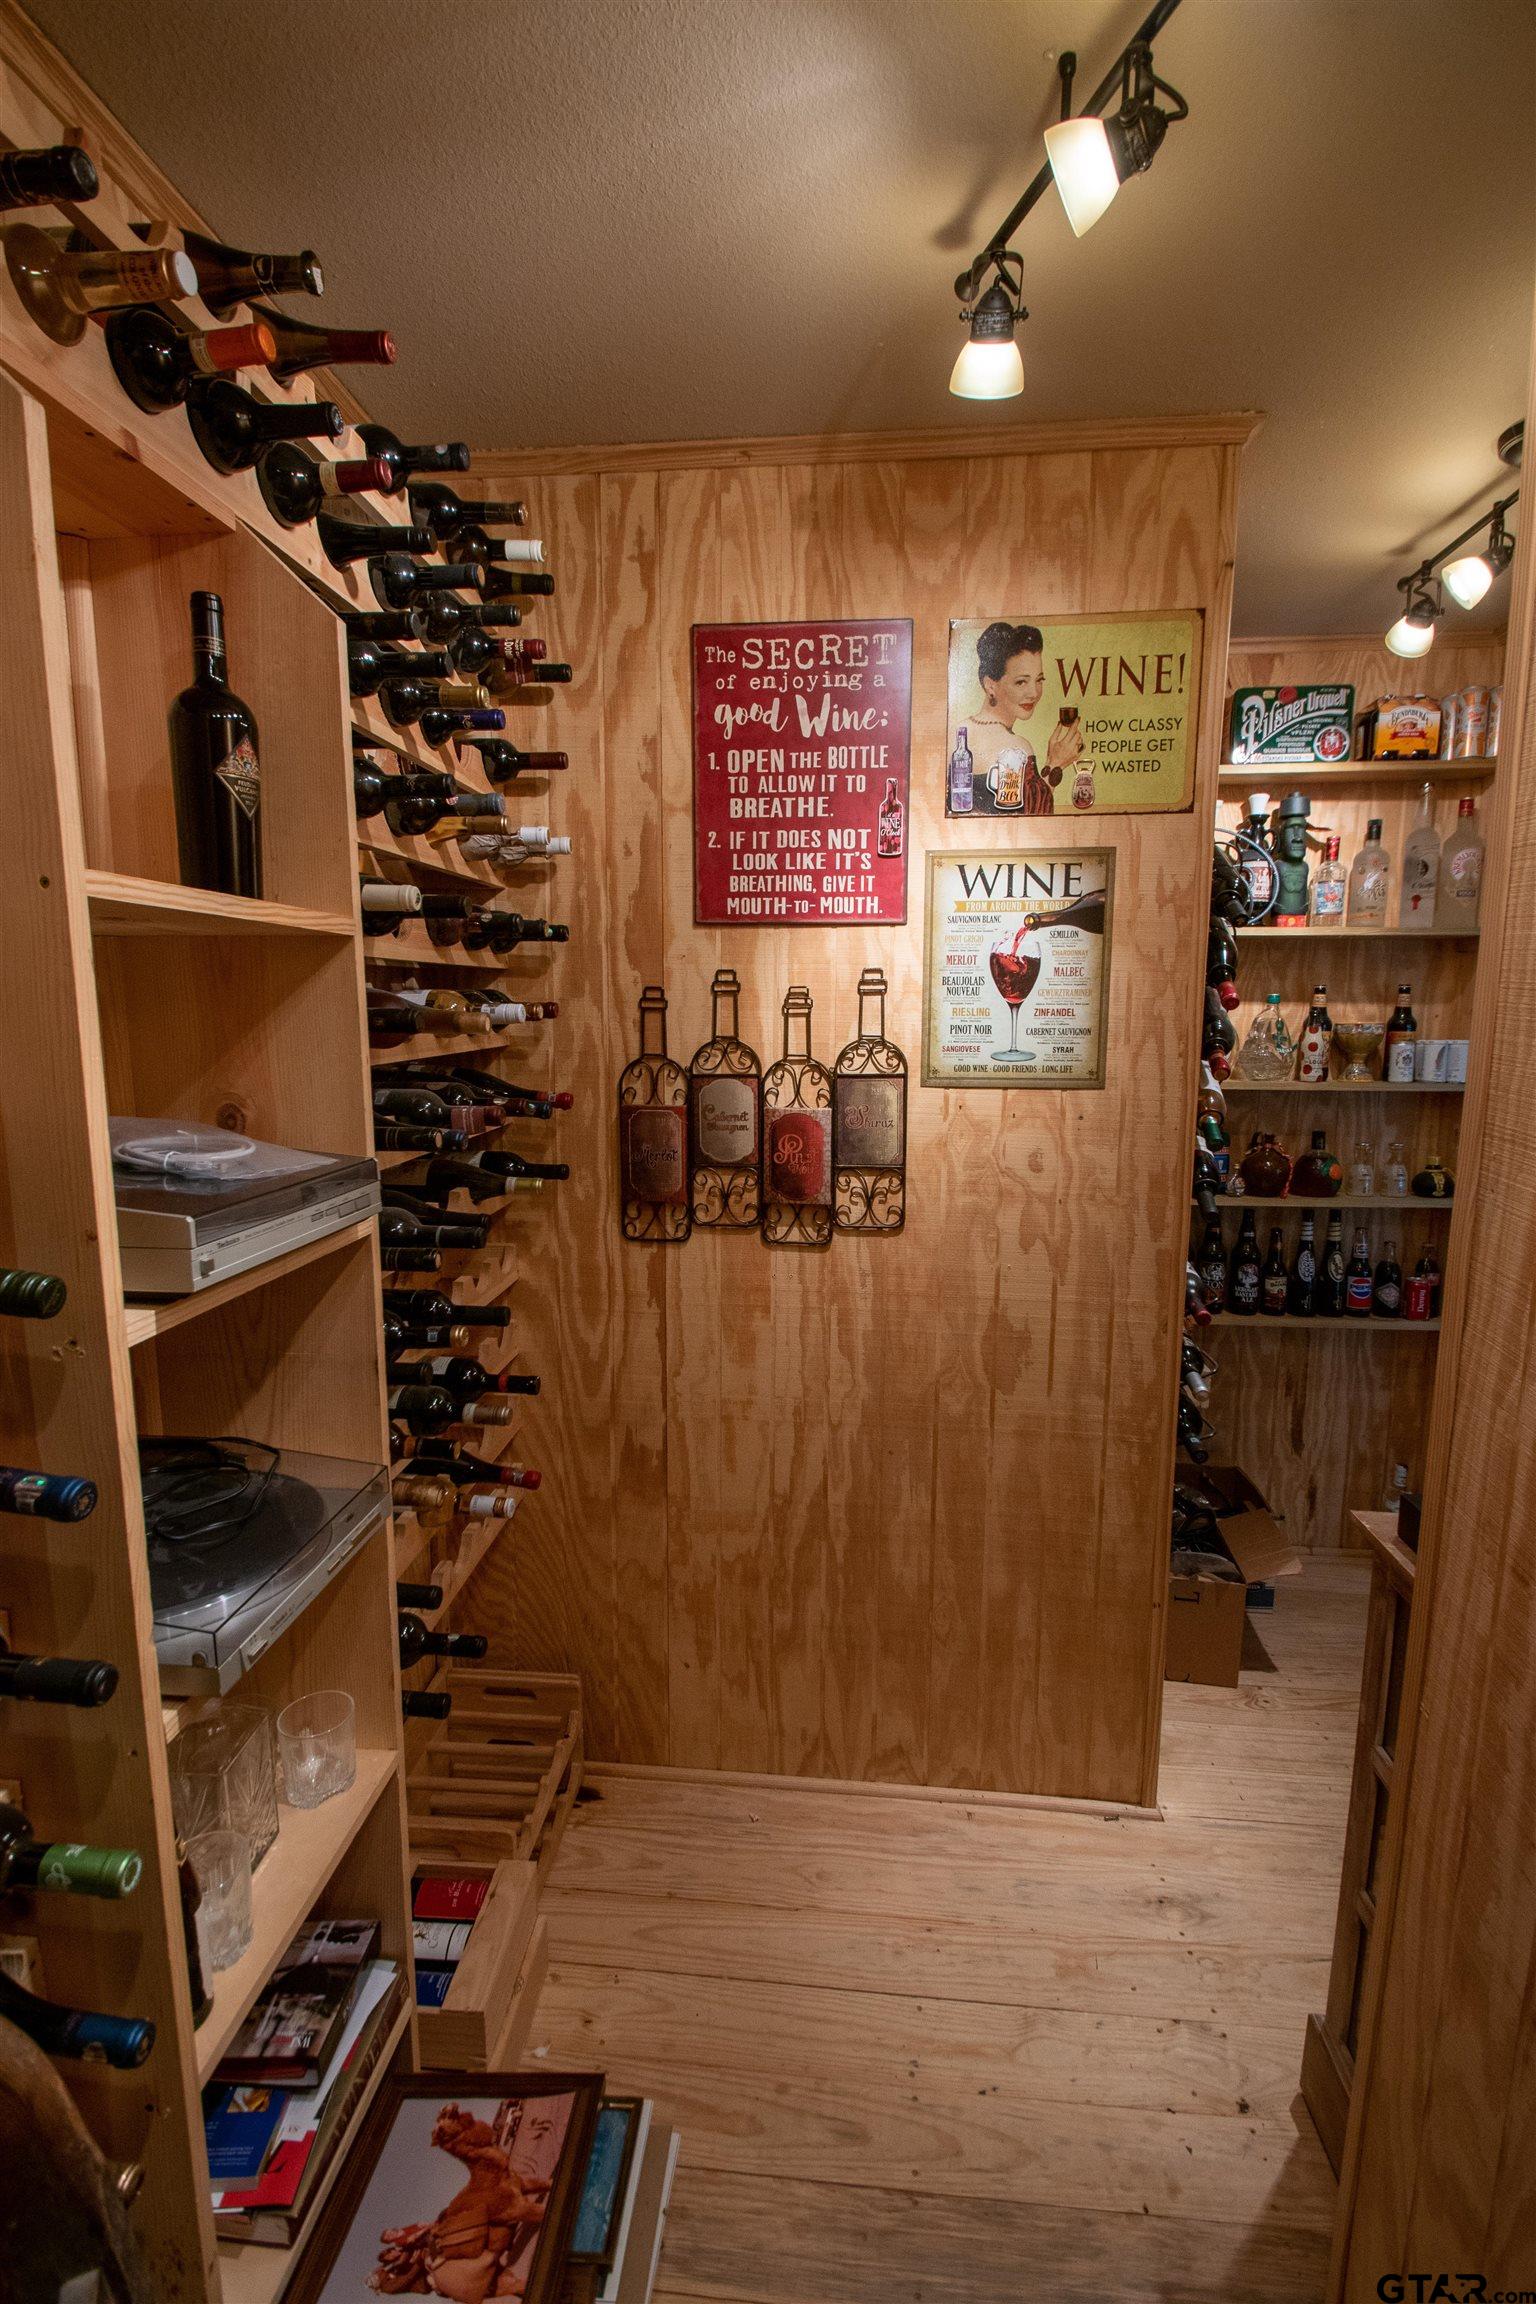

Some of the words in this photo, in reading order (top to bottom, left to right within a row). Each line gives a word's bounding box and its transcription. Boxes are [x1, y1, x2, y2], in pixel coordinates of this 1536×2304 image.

[705, 646, 736, 664] The
[742, 634, 898, 670] SECRET
[716, 674, 736, 690] of
[750, 671, 863, 692] enjoying
[873, 674, 886, 688] a
[1055, 653, 1186, 698] WINE!
[714, 698, 789, 740] good
[796, 693, 888, 738] Wine:
[1085, 719, 1124, 733] HOW
[1128, 717, 1183, 732] CLASSY
[1241, 694, 1307, 756] Pilsner
[1091, 738, 1142, 753] PEOPLE
[1147, 738, 1175, 752] GET
[708, 752, 720, 771] 1.
[728, 749, 784, 773] OPEN
[790, 752, 821, 769] THE
[828, 746, 888, 769] BOTTLE
[1101, 759, 1161, 774] WASTED
[728, 776, 748, 793] TO
[758, 775, 815, 793] ALLOW
[821, 774, 837, 793] IT
[845, 774, 866, 793] TO
[730, 797, 834, 818] BREATHE.
[708, 832, 721, 848] 2.
[730, 831, 745, 849] IF
[752, 830, 770, 849] IT
[777, 830, 821, 849] DOES
[828, 829, 871, 850] NOT
[733, 853, 779, 871] LOOK
[786, 852, 826, 870] LIKE
[835, 852, 871, 870] IT'S
[730, 875, 816, 893] BREATHING,
[823, 875, 855, 893] GIVE
[861, 874, 875, 892] IT
[955, 862, 1083, 899] WINE
[965, 901, 988, 911] FROM
[991, 901, 1022, 911] AROUND
[1024, 901, 1040, 911] THE
[1043, 901, 1070, 911] WORLD
[947, 916, 981, 924] SAUVIGNON
[982, 915, 1002, 923] BLANC
[946, 955, 977, 966] MERLOT
[1054, 967, 1085, 977] MALBEC
[942, 976, 985, 986] BEAUJOLAIS
[946, 987, 980, 996] NOUVEAU
[952, 1007, 991, 1017] RIESLING
[1034, 1008, 1076, 1017] ZINFANDEL
[950, 1025, 972, 1035] PINOT
[974, 1025, 993, 1035] NOIR
[1025, 1027, 1056, 1036] CABERNET
[1057, 1027, 1092, 1036] SAUVIGNON
[942, 1045, 981, 1053] SANGIOVESE
[953, 1064, 972, 1073] GOOD
[973, 1064, 988, 1073] WINE
[993, 1064, 1011, 1073] GOOD
[1011, 1064, 1038, 1073] FRIENDS
[1041, 1064, 1059, 1074] LONG
[1059, 1064, 1074, 1073] LIFE
[845, 1104, 896, 1129] Shiraz
